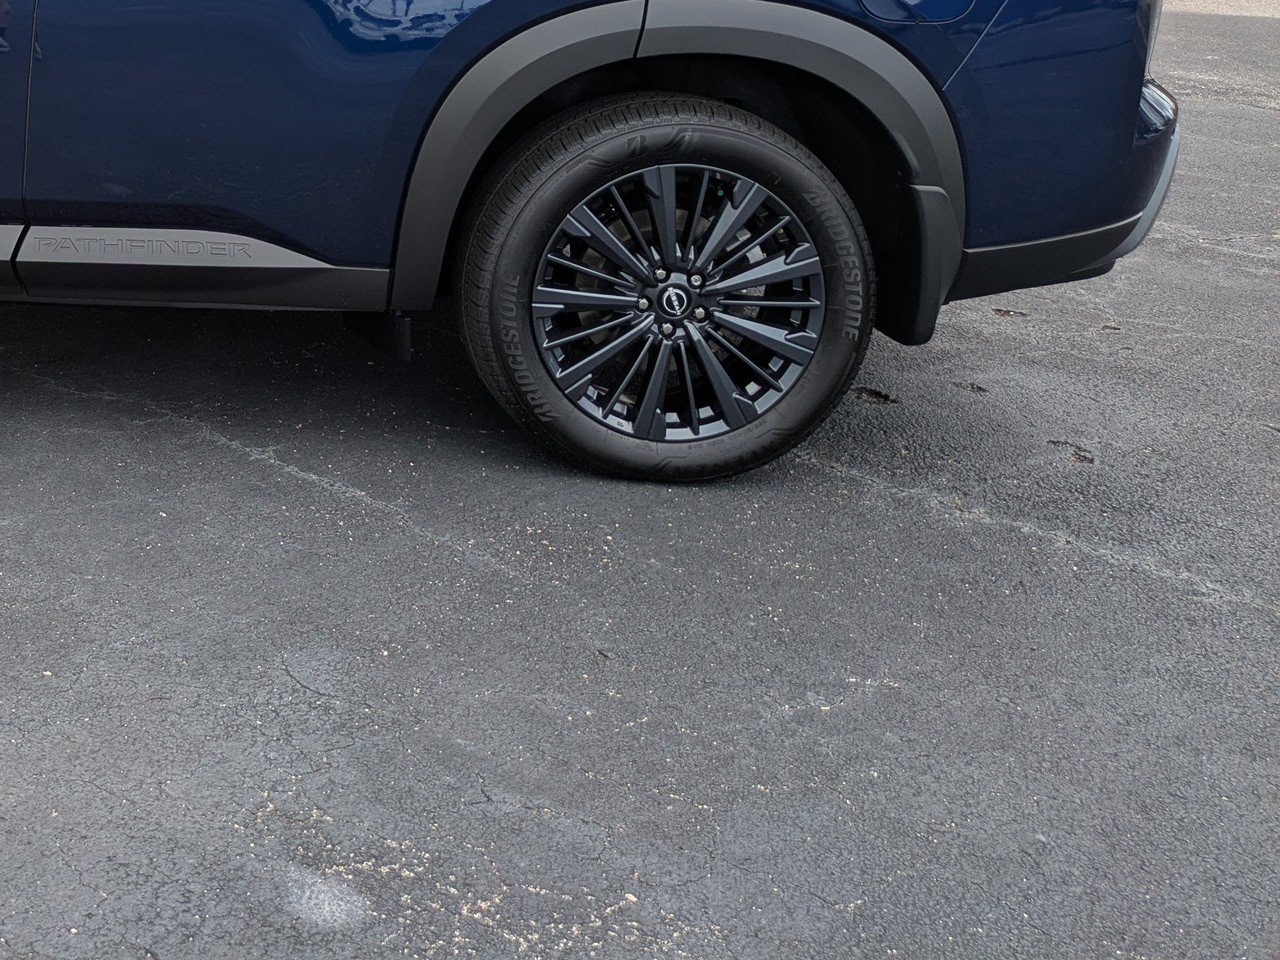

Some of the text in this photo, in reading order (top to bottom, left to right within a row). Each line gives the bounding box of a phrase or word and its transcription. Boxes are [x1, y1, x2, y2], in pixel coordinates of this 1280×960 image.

[33, 237, 252, 258] PATHFINDER
[800, 186, 863, 342] BRIDGESTONE
[499, 274, 562, 421] BRIDGESTONE
